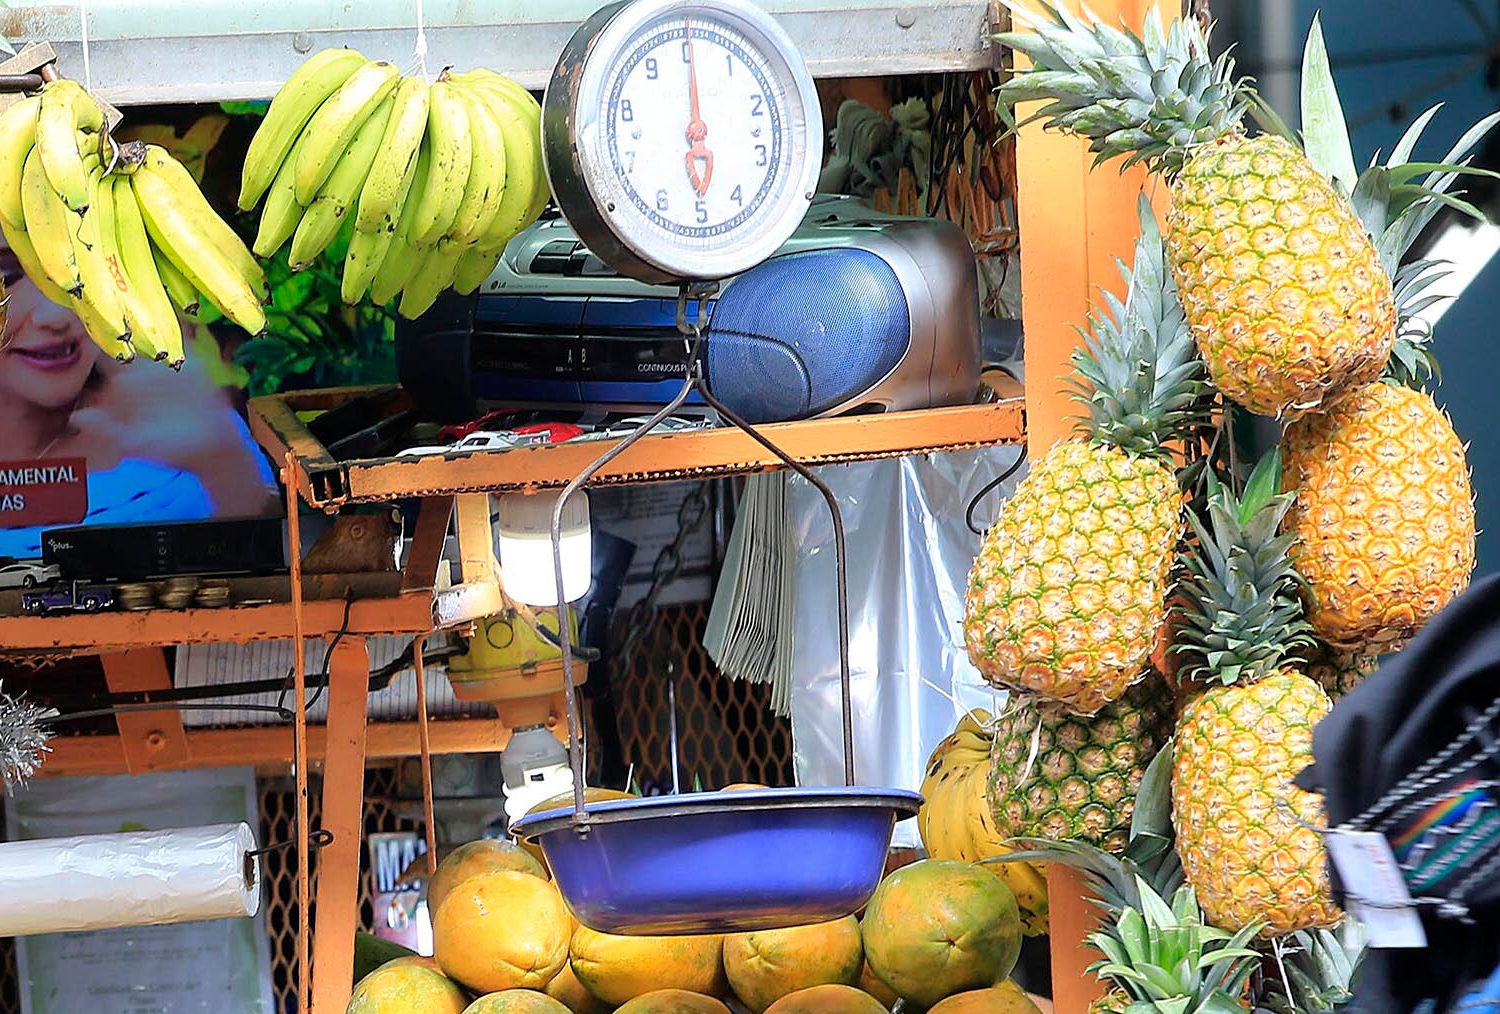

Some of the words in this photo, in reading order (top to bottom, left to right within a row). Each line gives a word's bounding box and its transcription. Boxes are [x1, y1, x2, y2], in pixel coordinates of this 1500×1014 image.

[645, 58, 658, 79] 9
[726, 55, 733, 76] 1
[621, 99, 633, 121] 8
[750, 95, 764, 116] 2
[755, 145, 767, 166] 3
[730, 185, 743, 206] 4
[695, 201, 708, 223] 5
